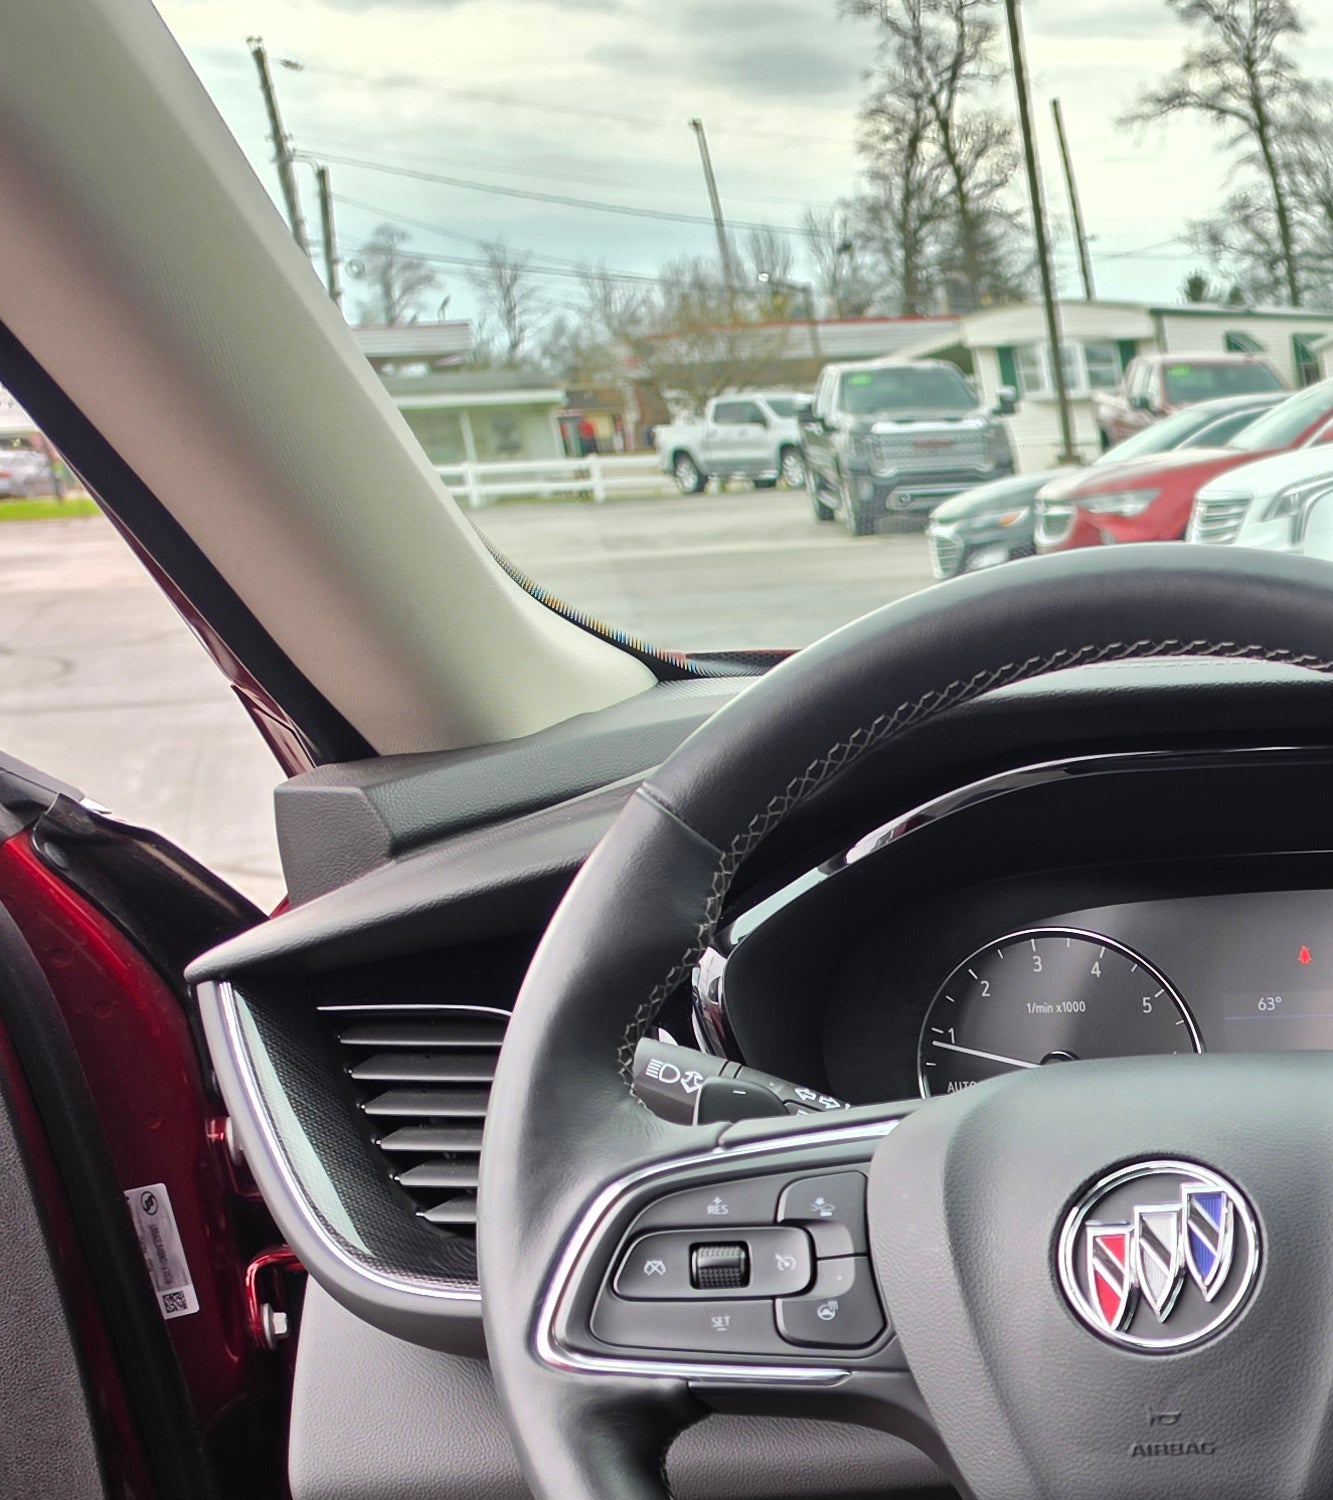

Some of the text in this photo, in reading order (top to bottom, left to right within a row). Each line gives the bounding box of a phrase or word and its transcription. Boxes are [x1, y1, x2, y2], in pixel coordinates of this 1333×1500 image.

[1032, 956, 1043, 972] 3
[1090, 961, 1101, 977] 4
[980, 980, 991, 997] 2
[1026, 1000, 1086, 1014] 1/min x1000
[1142, 997, 1152, 1013] 5
[1257, 996, 1283, 1011] 63°
[948, 1027, 956, 1044] 1
[707, 1204, 729, 1215] RES
[1131, 1442, 1216, 1458] AIRBAG
